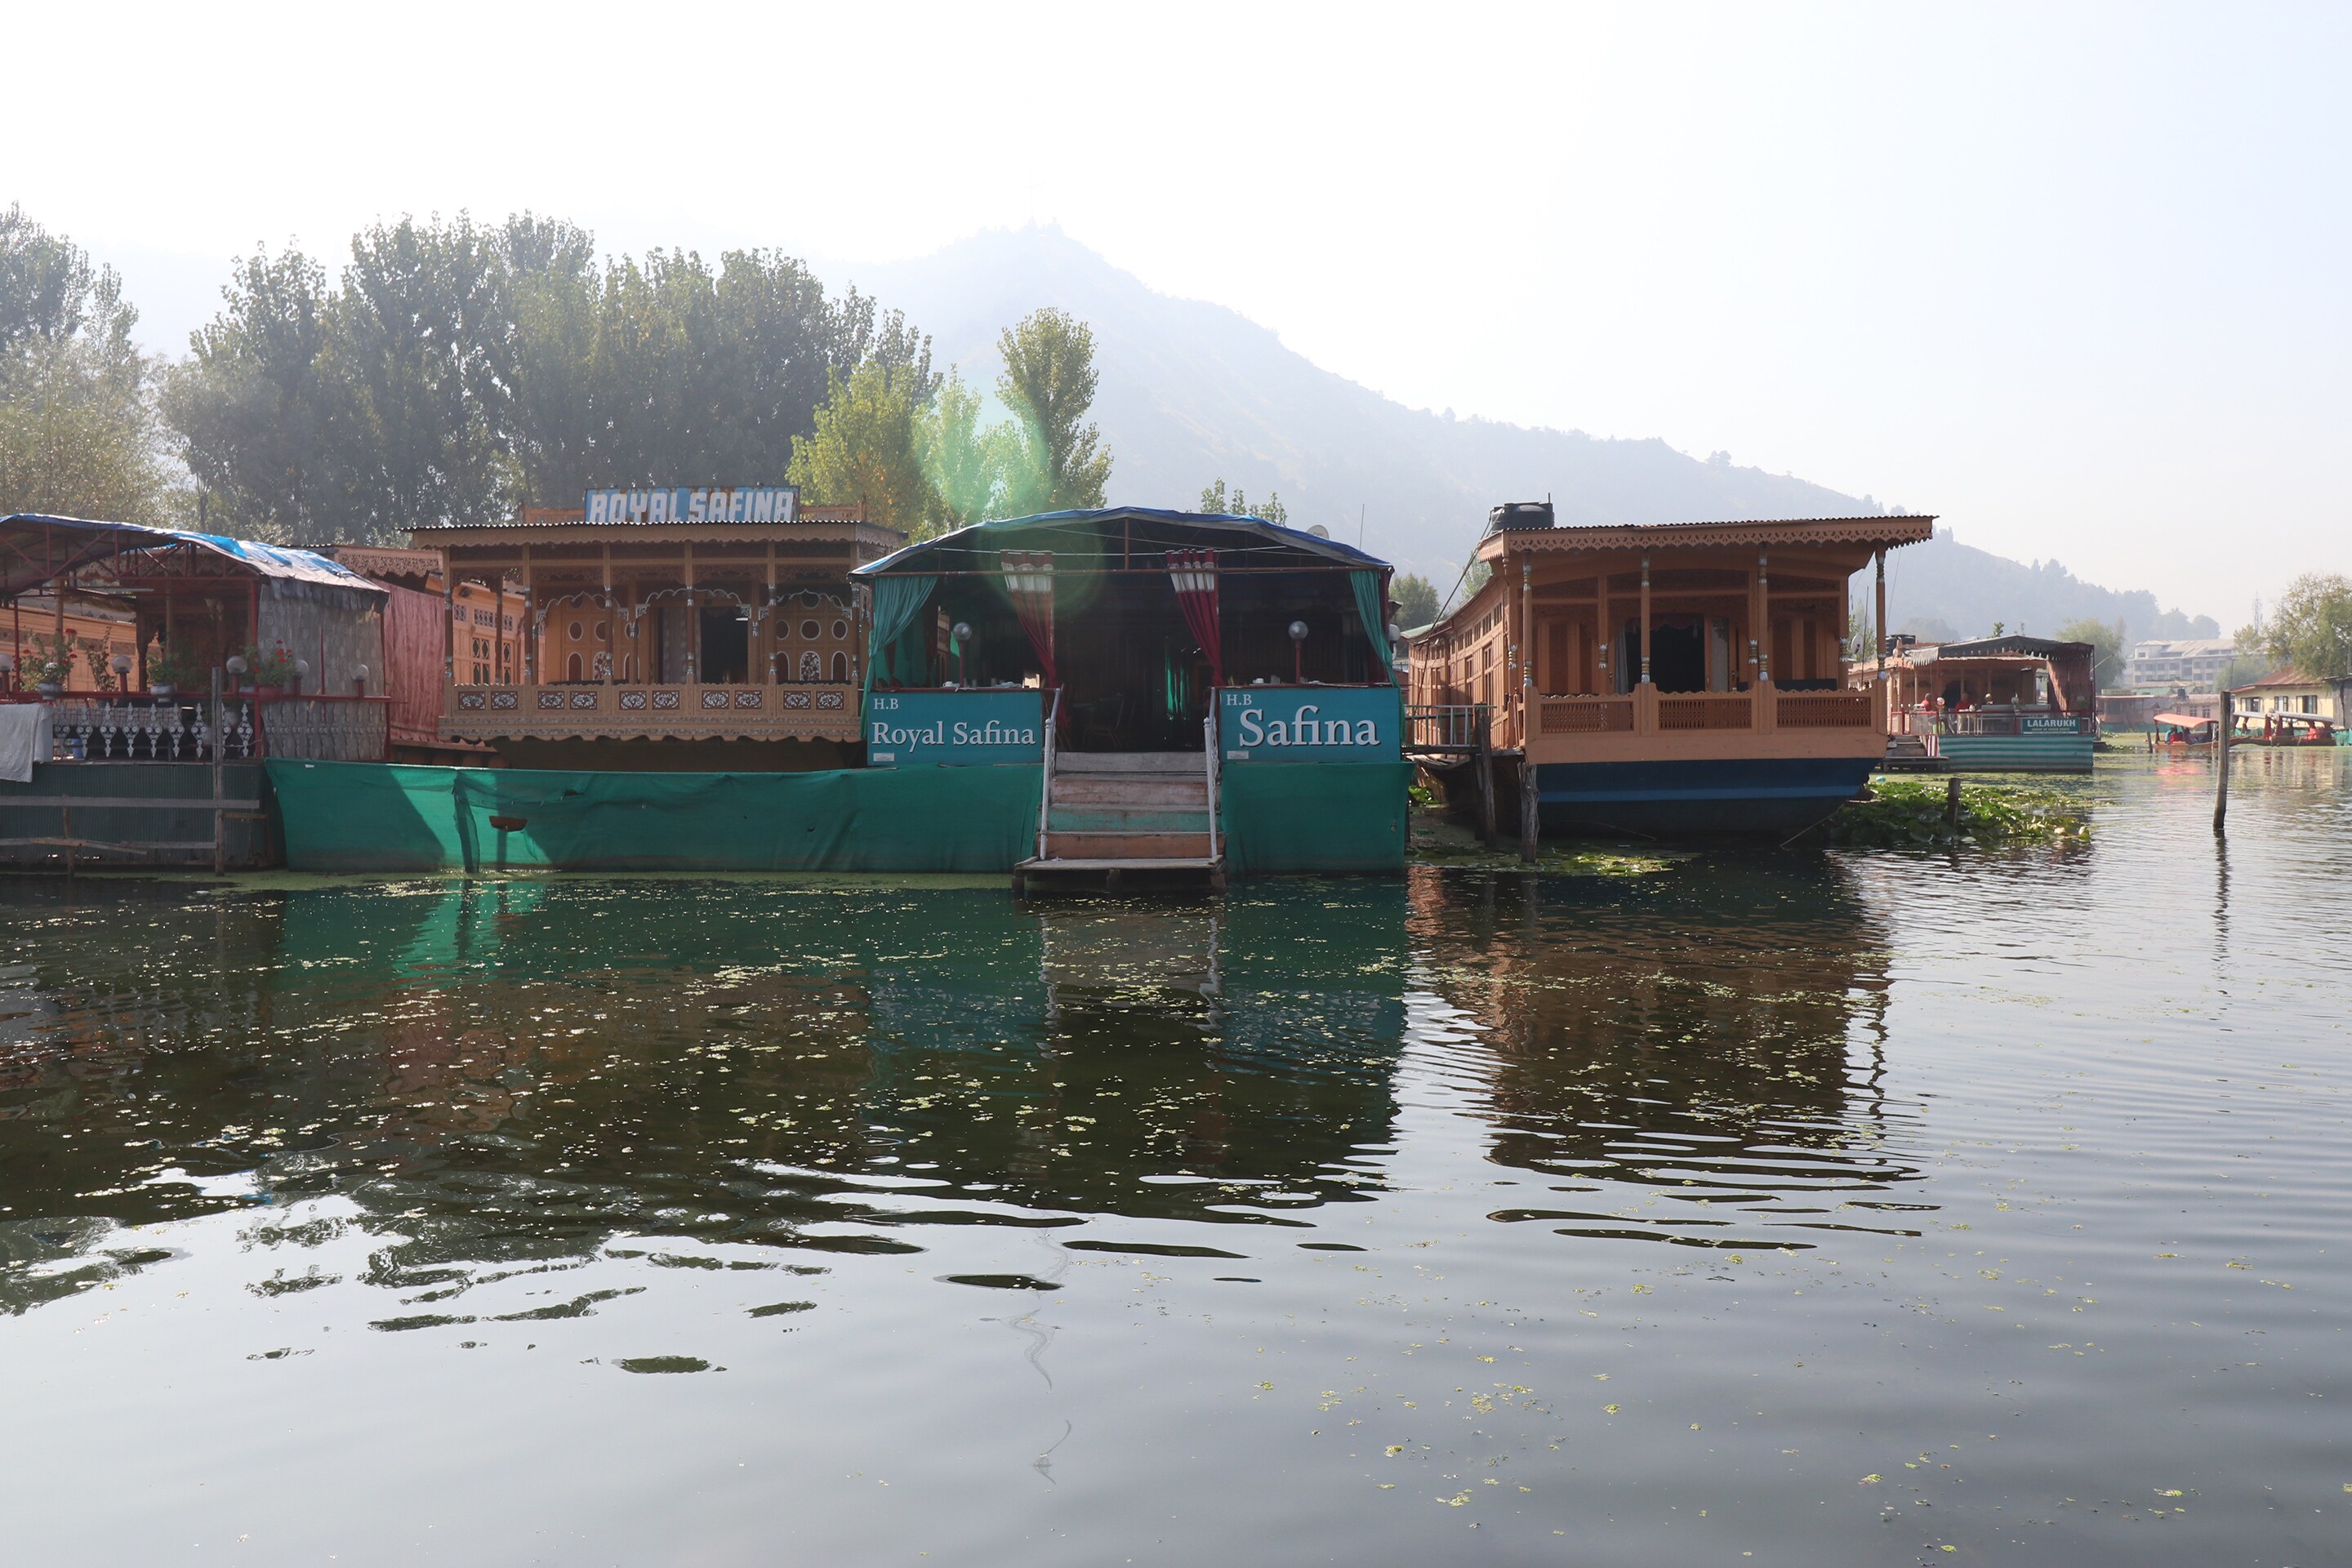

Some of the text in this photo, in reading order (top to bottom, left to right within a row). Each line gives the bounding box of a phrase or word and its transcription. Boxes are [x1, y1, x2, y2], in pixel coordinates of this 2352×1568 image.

[590, 492, 794, 523] ROYAL SAFINA
[873, 698, 898, 710] H.B
[1226, 694, 1252, 706] H.B
[1239, 705, 1380, 747] Safina
[2027, 719, 2076, 728] LALARUKH
[871, 719, 1036, 753] Royal Safina
